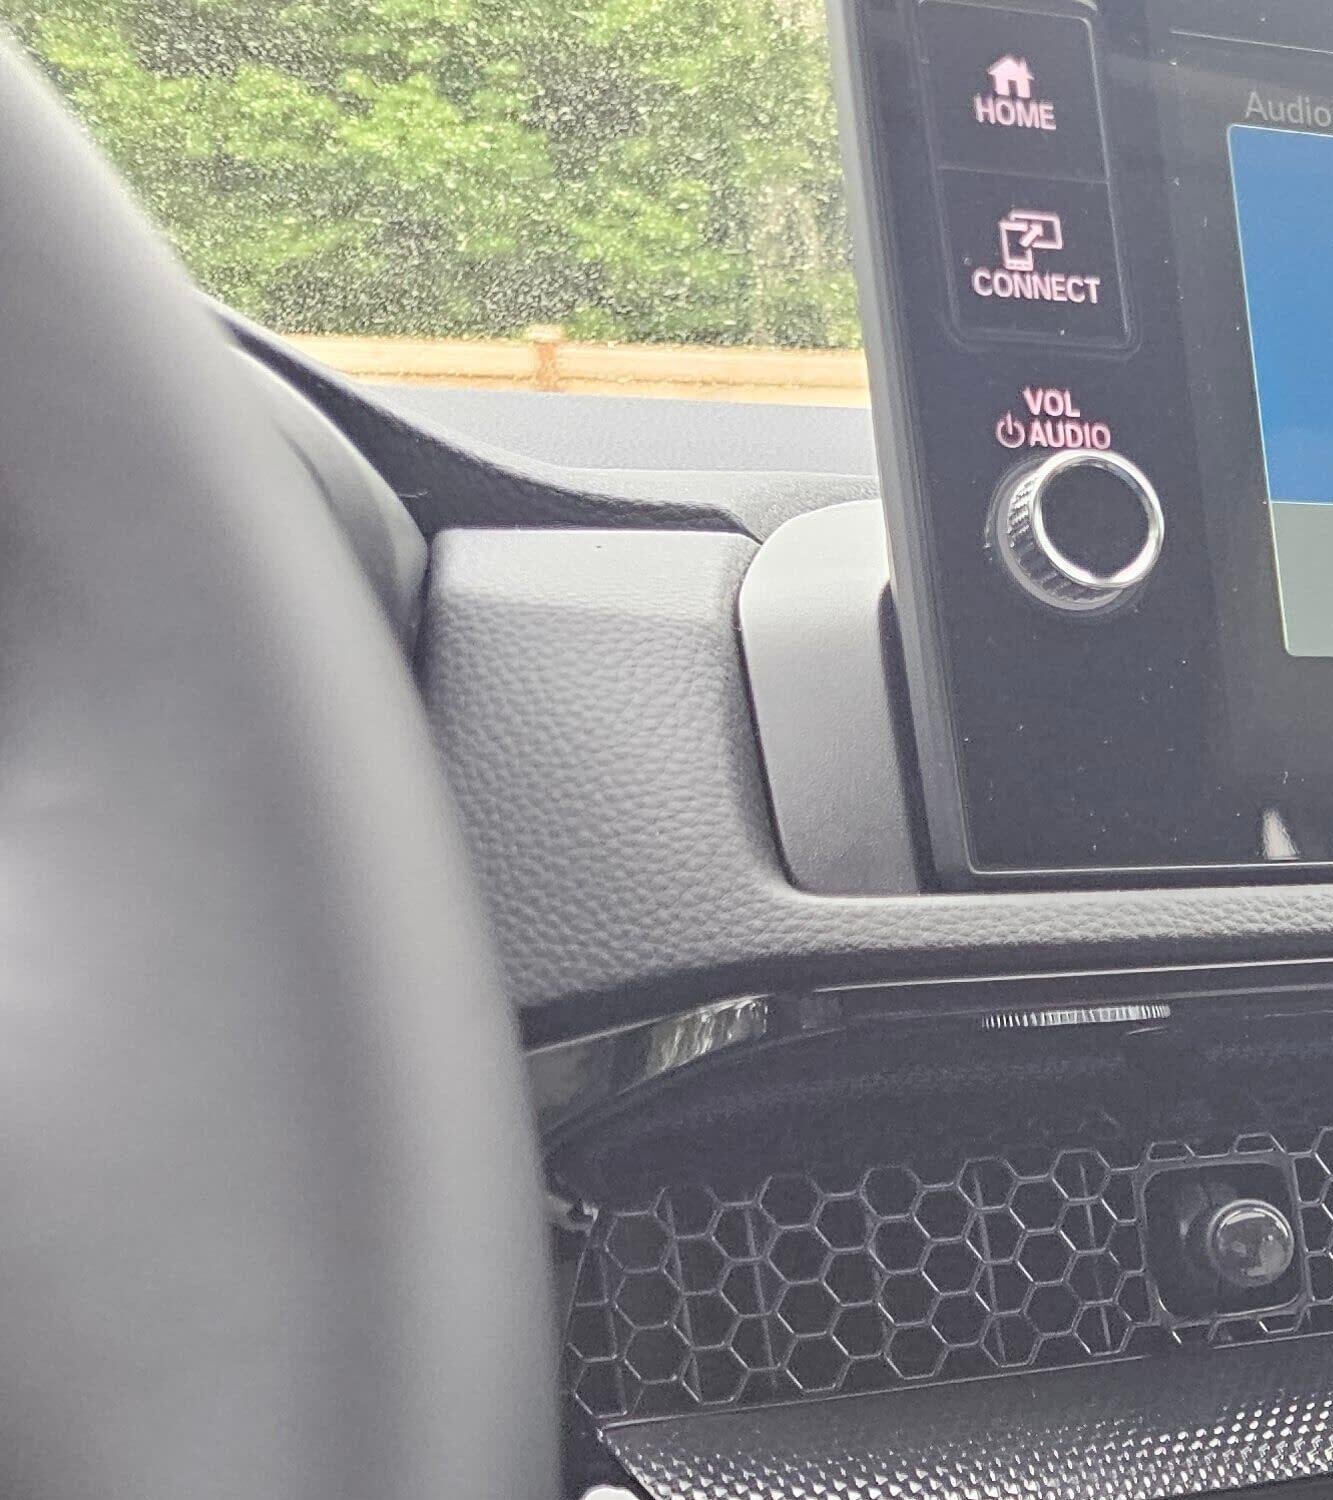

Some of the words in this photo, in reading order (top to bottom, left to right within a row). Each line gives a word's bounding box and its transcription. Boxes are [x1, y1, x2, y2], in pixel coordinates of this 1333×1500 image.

[974, 95, 1056, 130] HOME
[1245, 92, 1331, 129] Audio
[972, 269, 1101, 304] CONNECT
[1022, 389, 1080, 419] VOL
[1029, 420, 1111, 449] AUDIO
